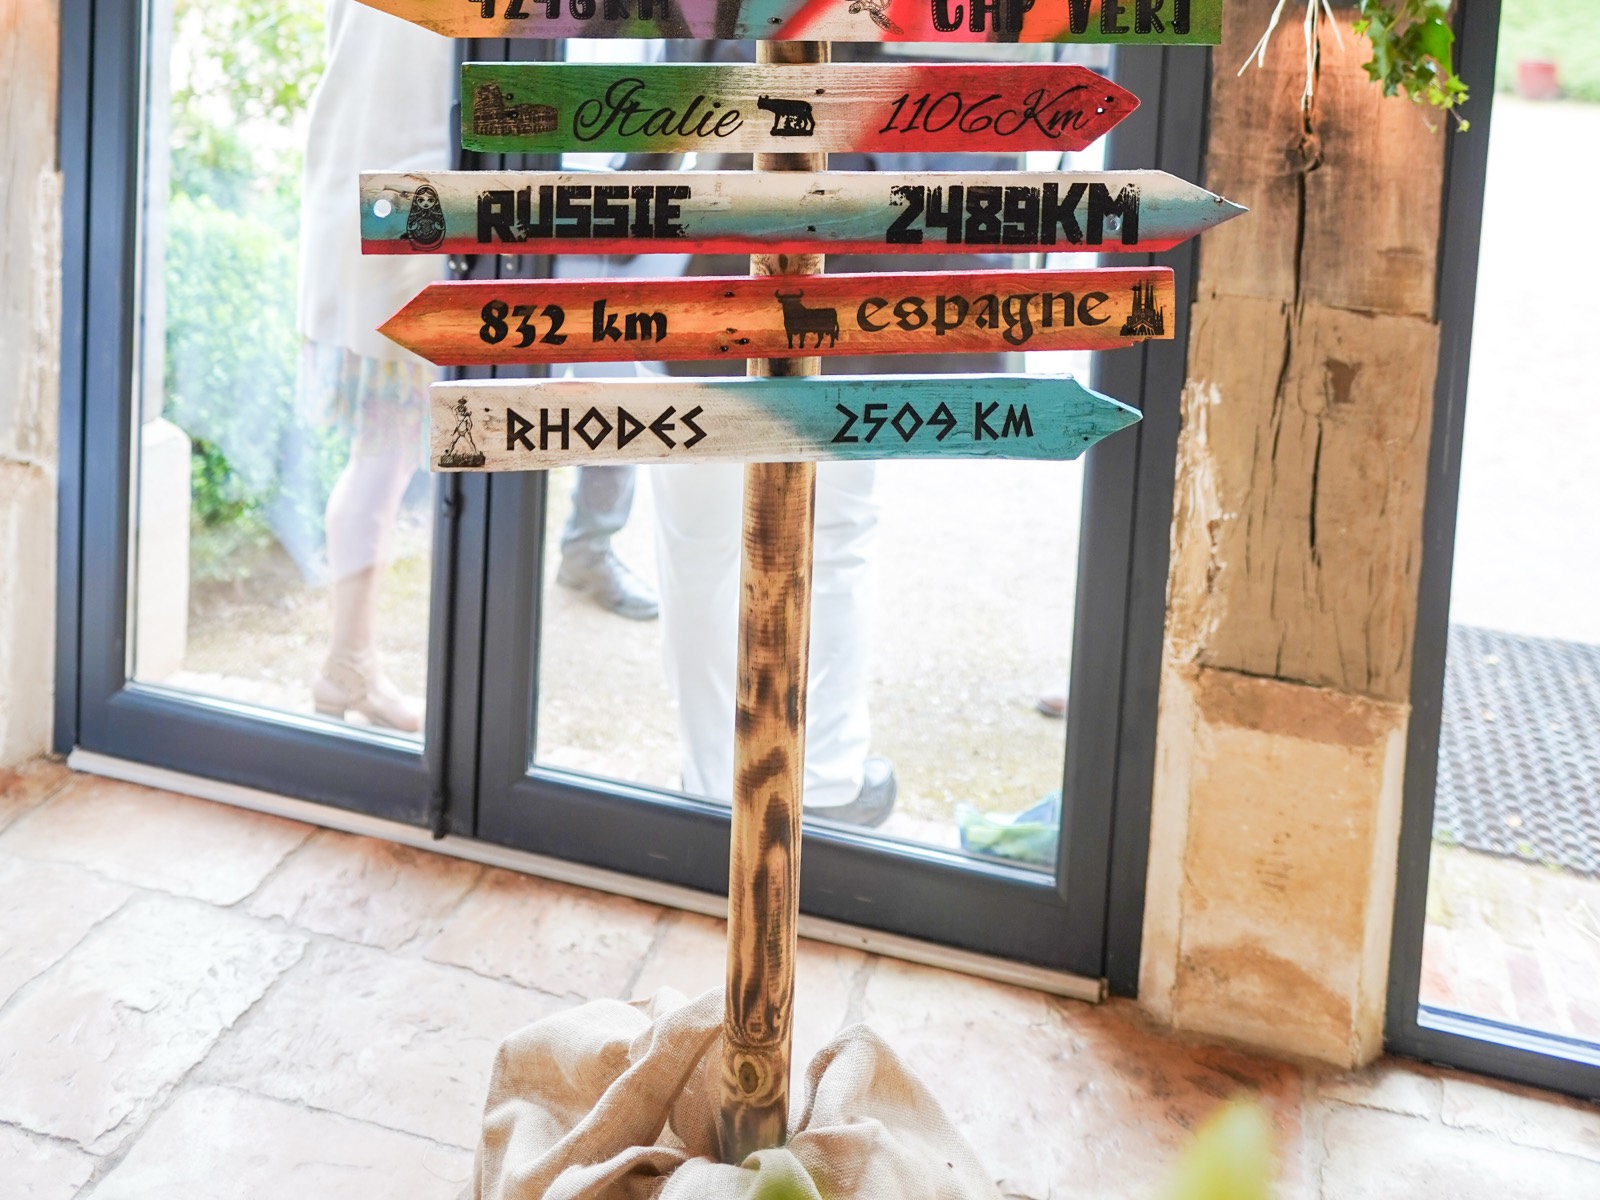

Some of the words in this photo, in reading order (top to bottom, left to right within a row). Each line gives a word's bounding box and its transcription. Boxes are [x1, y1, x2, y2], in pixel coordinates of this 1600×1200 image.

[573, 78, 744, 141] Italie
[879, 85, 1090, 139] 1106Km
[477, 185, 691, 243] RUSSIE
[885, 182, 1141, 245] 2489KM
[479, 299, 567, 348] 832
[593, 299, 667, 343] km
[857, 291, 1111, 345] espagne
[506, 406, 707, 451] RHODES
[831, 402, 957, 443] 2509
[975, 402, 1034, 441] KM
